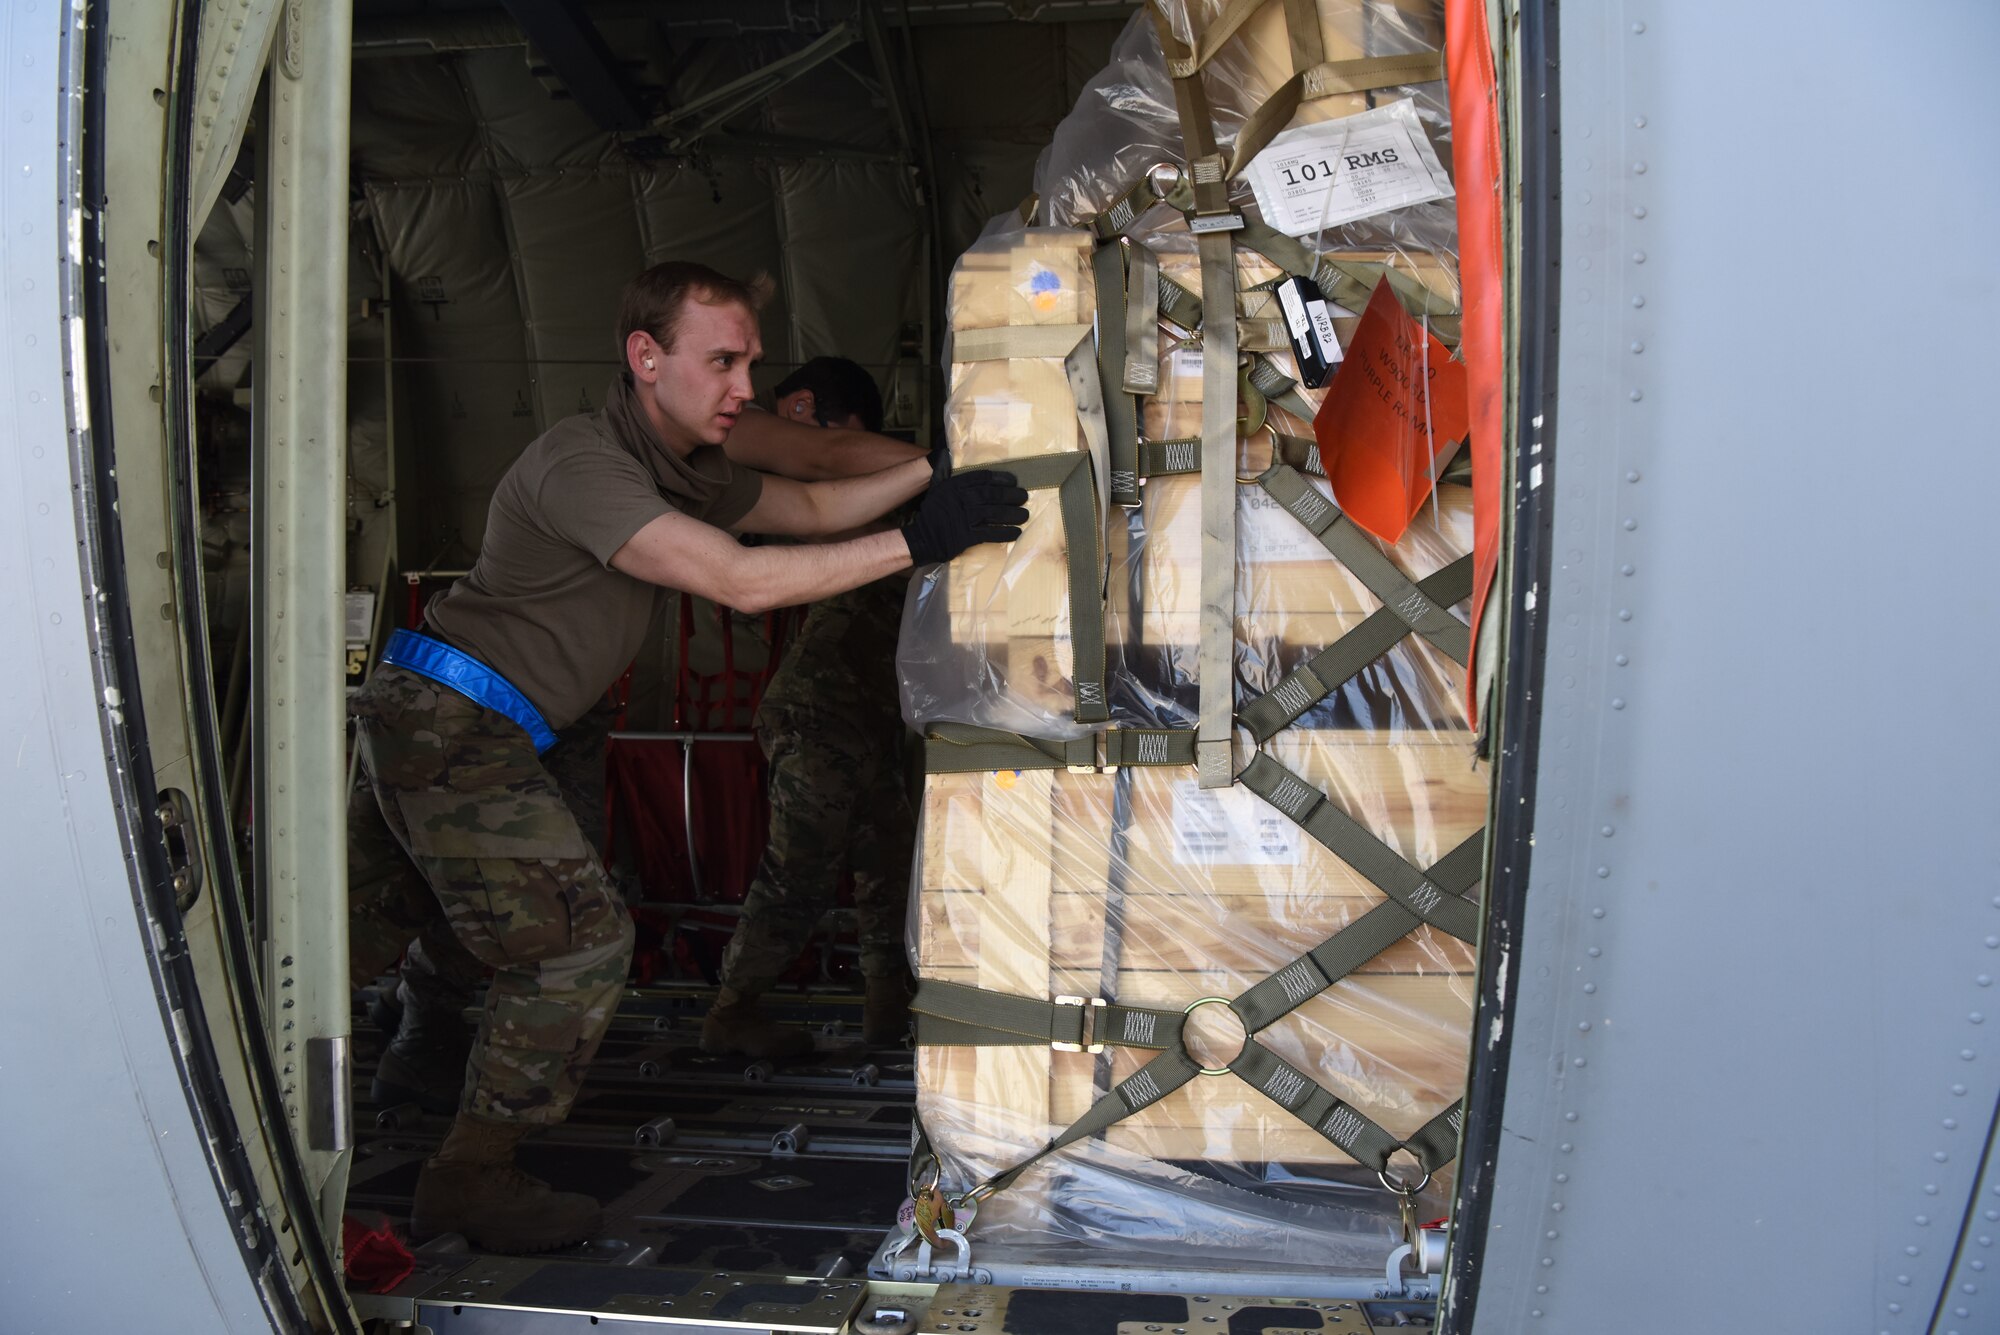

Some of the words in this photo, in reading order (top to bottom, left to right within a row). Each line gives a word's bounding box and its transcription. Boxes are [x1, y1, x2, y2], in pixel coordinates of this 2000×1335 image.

[1282, 160, 1335, 186] 101
[1343, 148, 1399, 170] RMS
[1359, 351, 1393, 404] PURPLE
